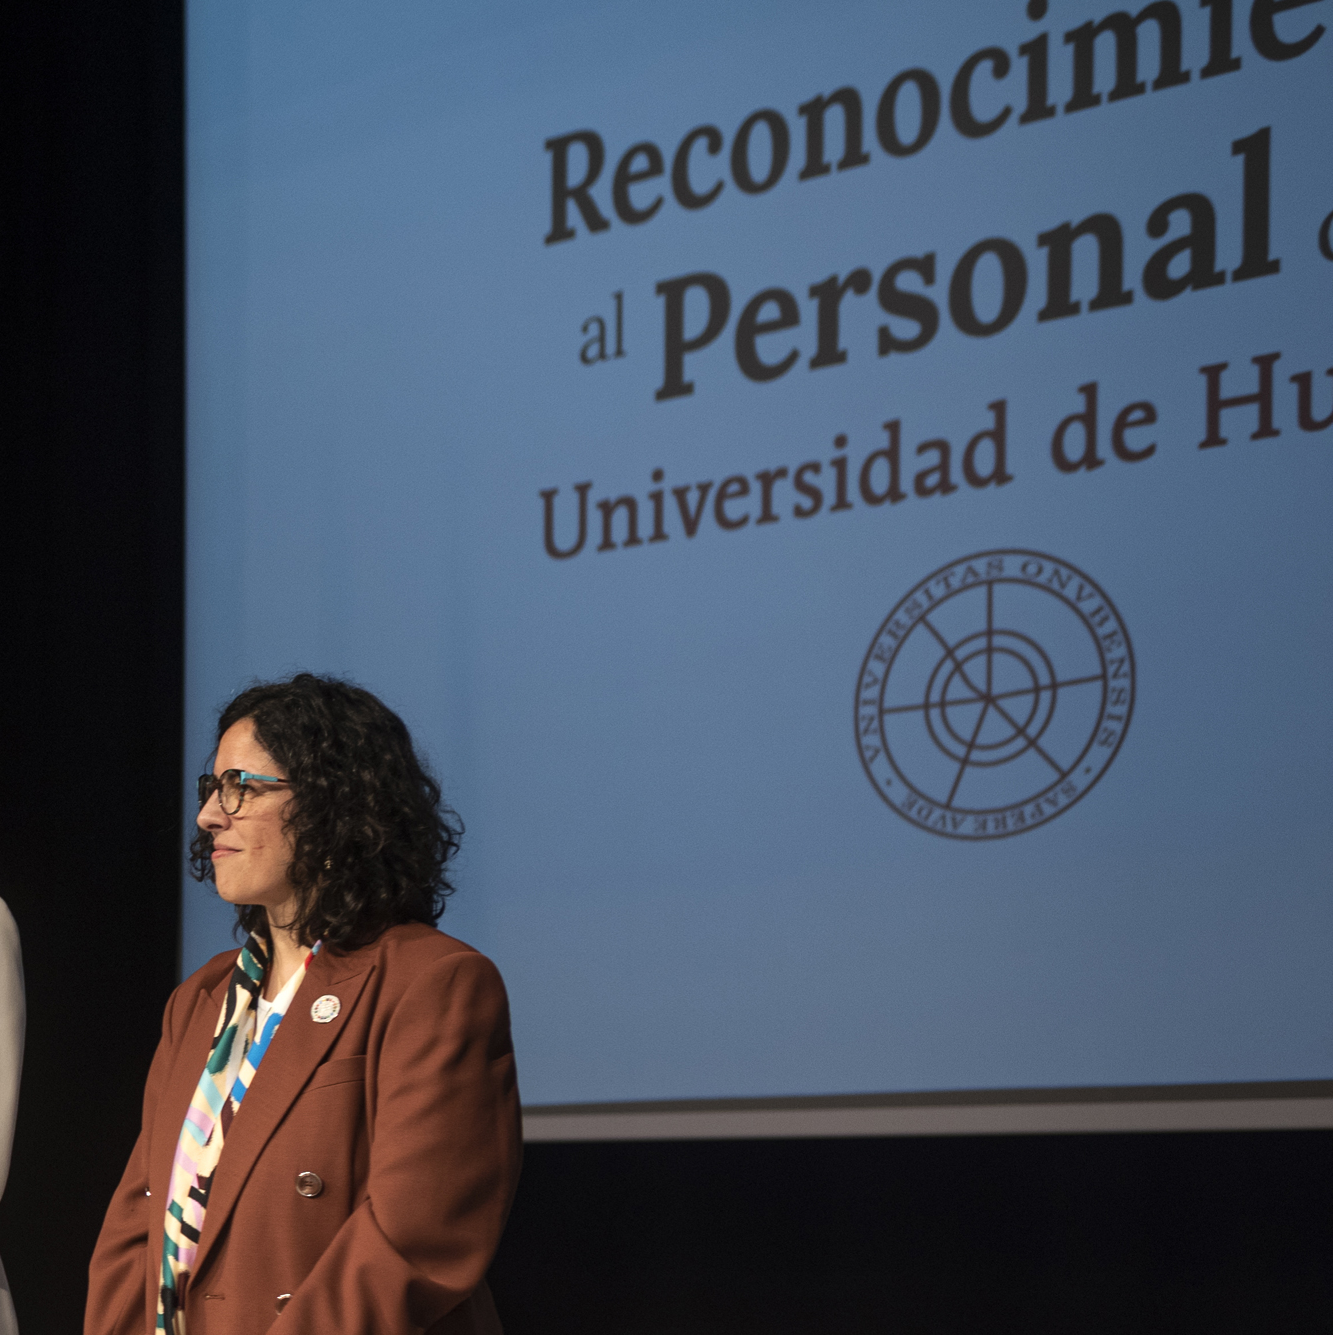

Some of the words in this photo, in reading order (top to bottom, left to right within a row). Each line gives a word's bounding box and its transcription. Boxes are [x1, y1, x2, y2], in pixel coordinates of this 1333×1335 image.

[578, 290, 626, 366] al
[654, 125, 1282, 401] Personal
[539, 398, 1014, 560] Universidad
[1050, 381, 1158, 473] de
[1020, 559, 1128, 749] ONVBENSIS
